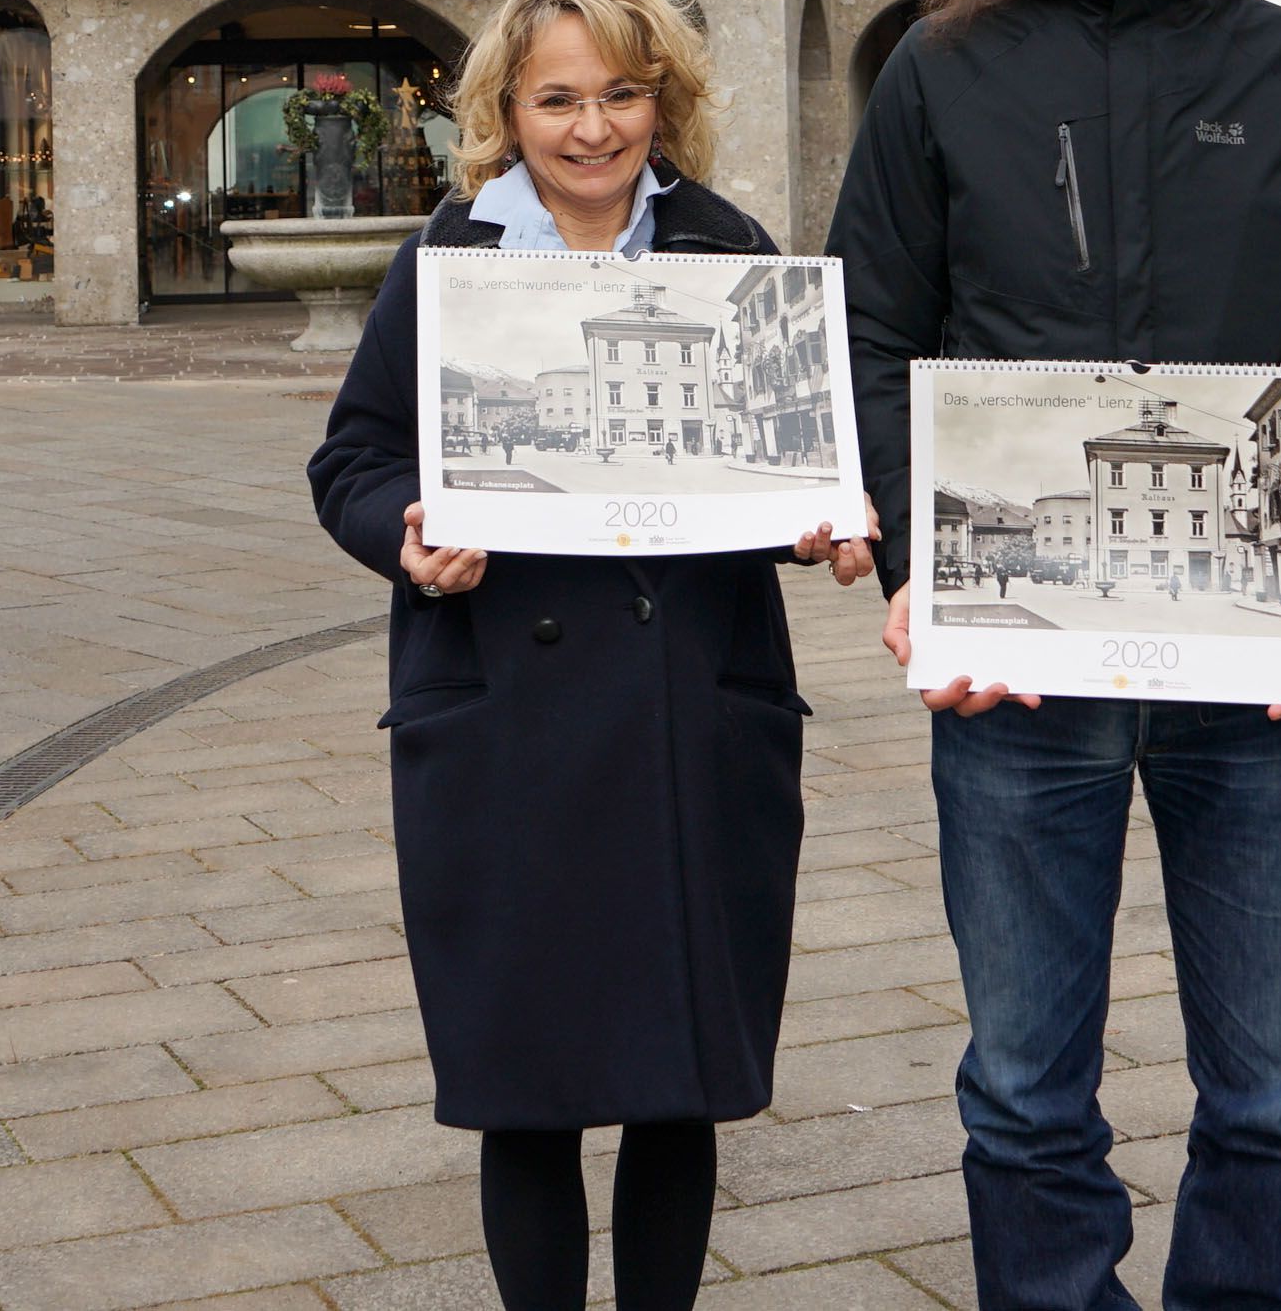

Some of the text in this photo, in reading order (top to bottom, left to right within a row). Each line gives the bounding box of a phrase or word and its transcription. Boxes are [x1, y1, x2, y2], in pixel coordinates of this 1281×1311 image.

[1195, 120, 1222, 133] Jack
[1196, 131, 1245, 145] Wolfskin
[449, 277, 473, 290] Das
[593, 281, 626, 293] Lienz
[944, 393, 969, 406] Das
[1098, 395, 1134, 409] Lienz
[605, 501, 678, 527] 2020
[1102, 639, 1179, 670] 2020
